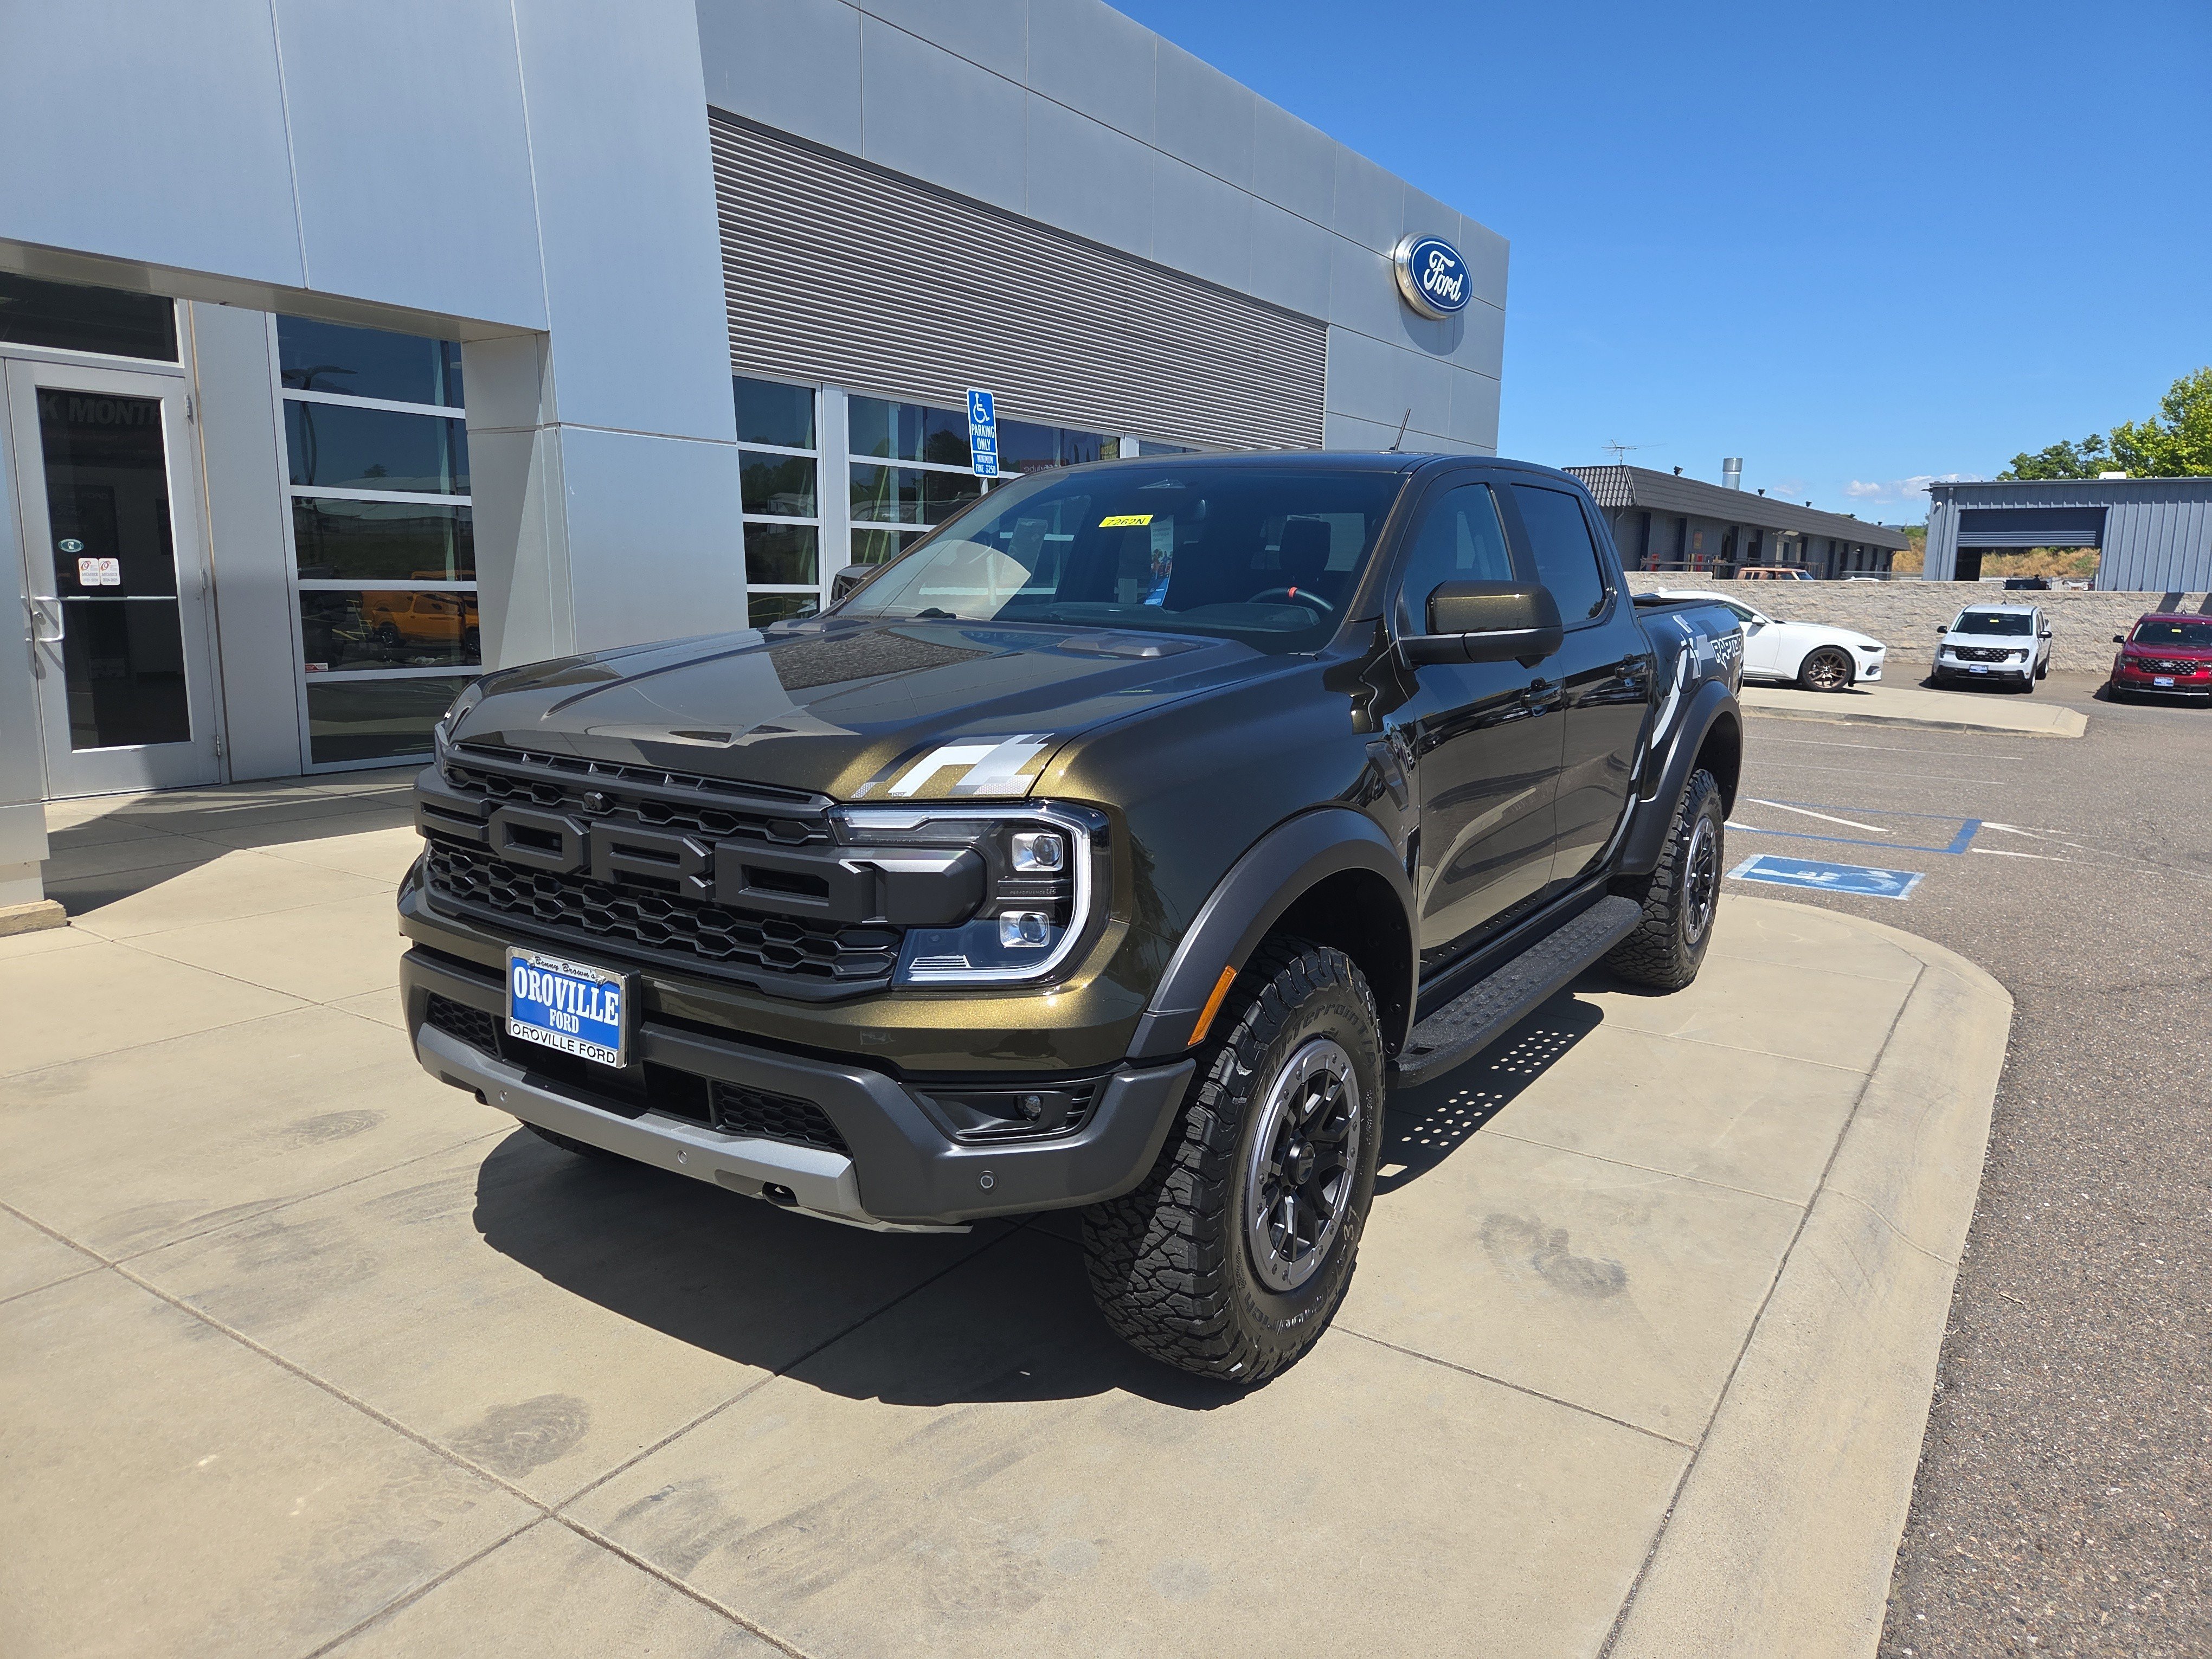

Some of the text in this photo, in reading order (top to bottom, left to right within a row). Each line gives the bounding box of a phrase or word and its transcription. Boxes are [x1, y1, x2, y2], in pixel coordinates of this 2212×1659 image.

[1424, 250, 1463, 302] Ford
[972, 423, 995, 439] PARKING
[977, 438, 991, 451] ONLY
[975, 464, 996, 474] FINE $250
[976, 454, 993, 464] MINIMUM
[1711, 633, 1742, 671] RAPTOR
[413, 779, 874, 924] FORD
[534, 956, 596, 979] Benny Brown's
[513, 966, 619, 1026] OROVILLE
[549, 1008, 580, 1034] FORD
[512, 1023, 615, 1064] OROVILLE FORD
